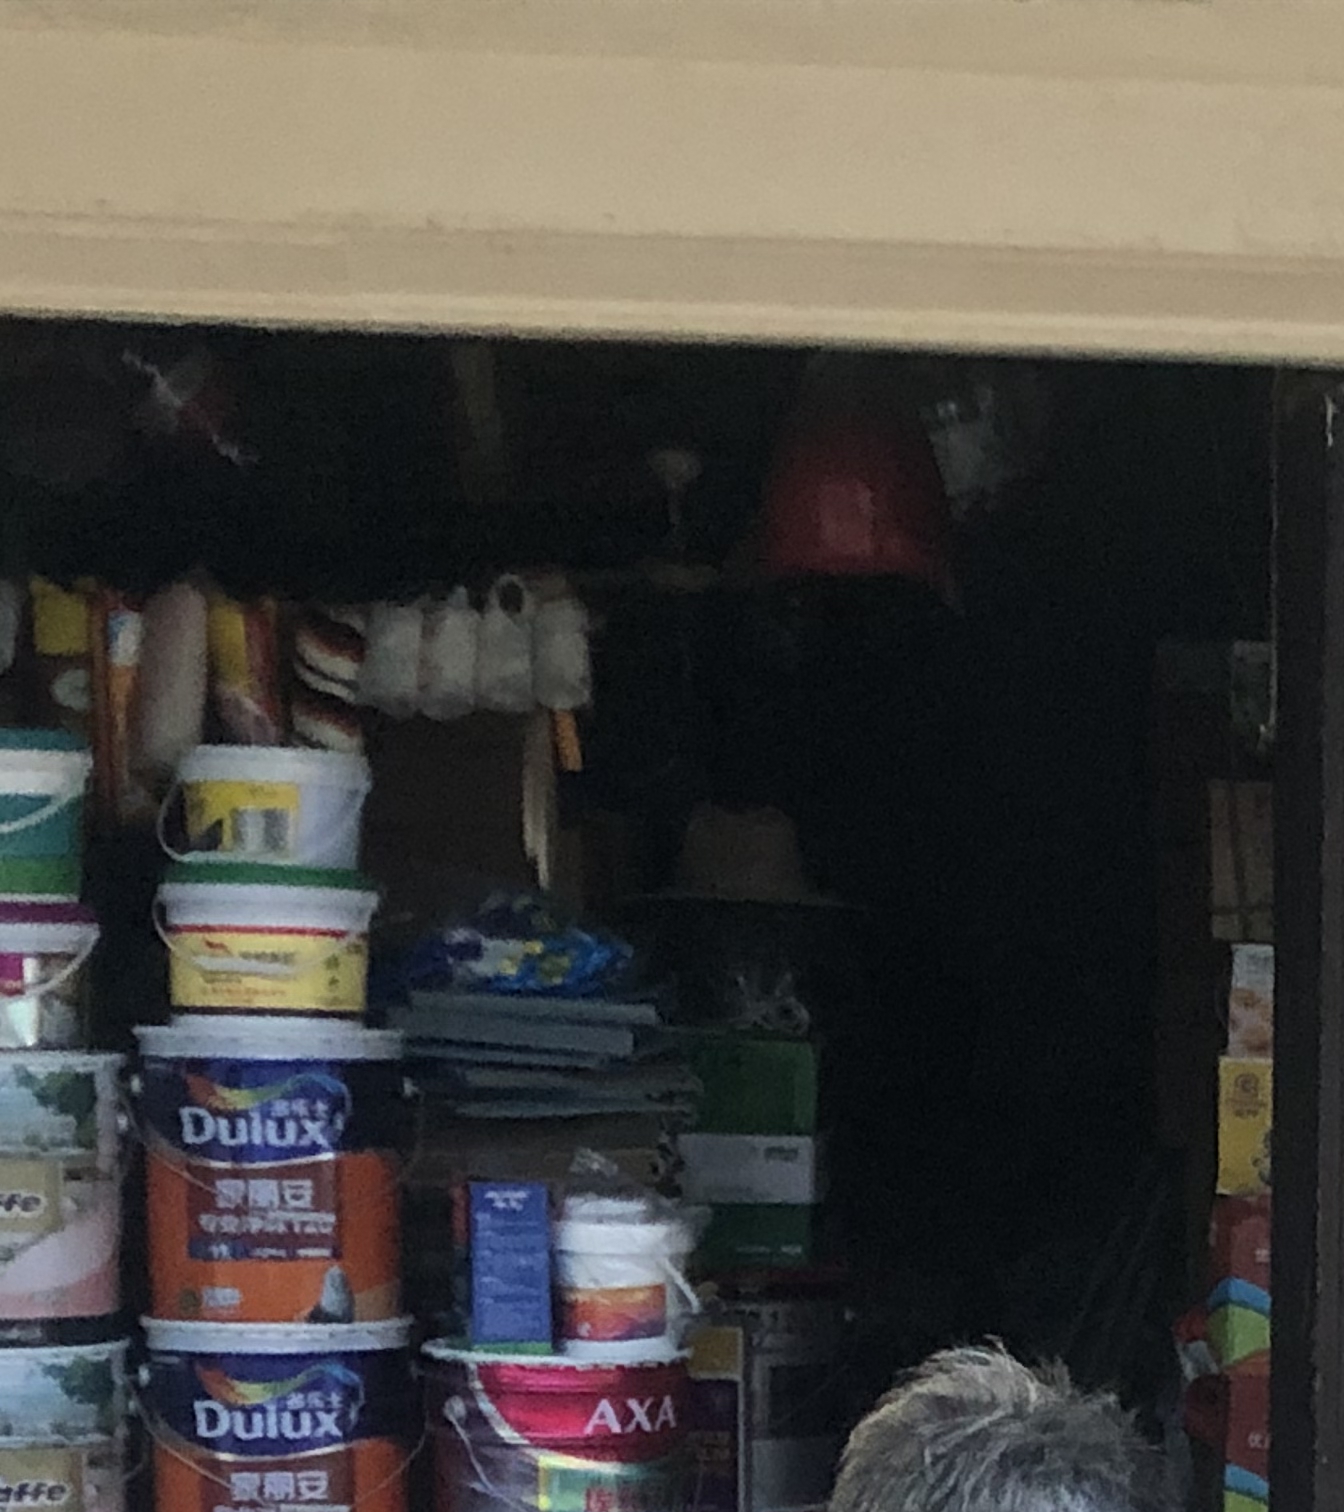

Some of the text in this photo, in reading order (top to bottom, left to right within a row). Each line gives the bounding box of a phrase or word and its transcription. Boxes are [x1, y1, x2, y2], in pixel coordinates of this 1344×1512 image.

[179, 1106, 329, 1149] Dulux
[193, 1400, 343, 1440] Dulux
[584, 1396, 677, 1434] AXA
